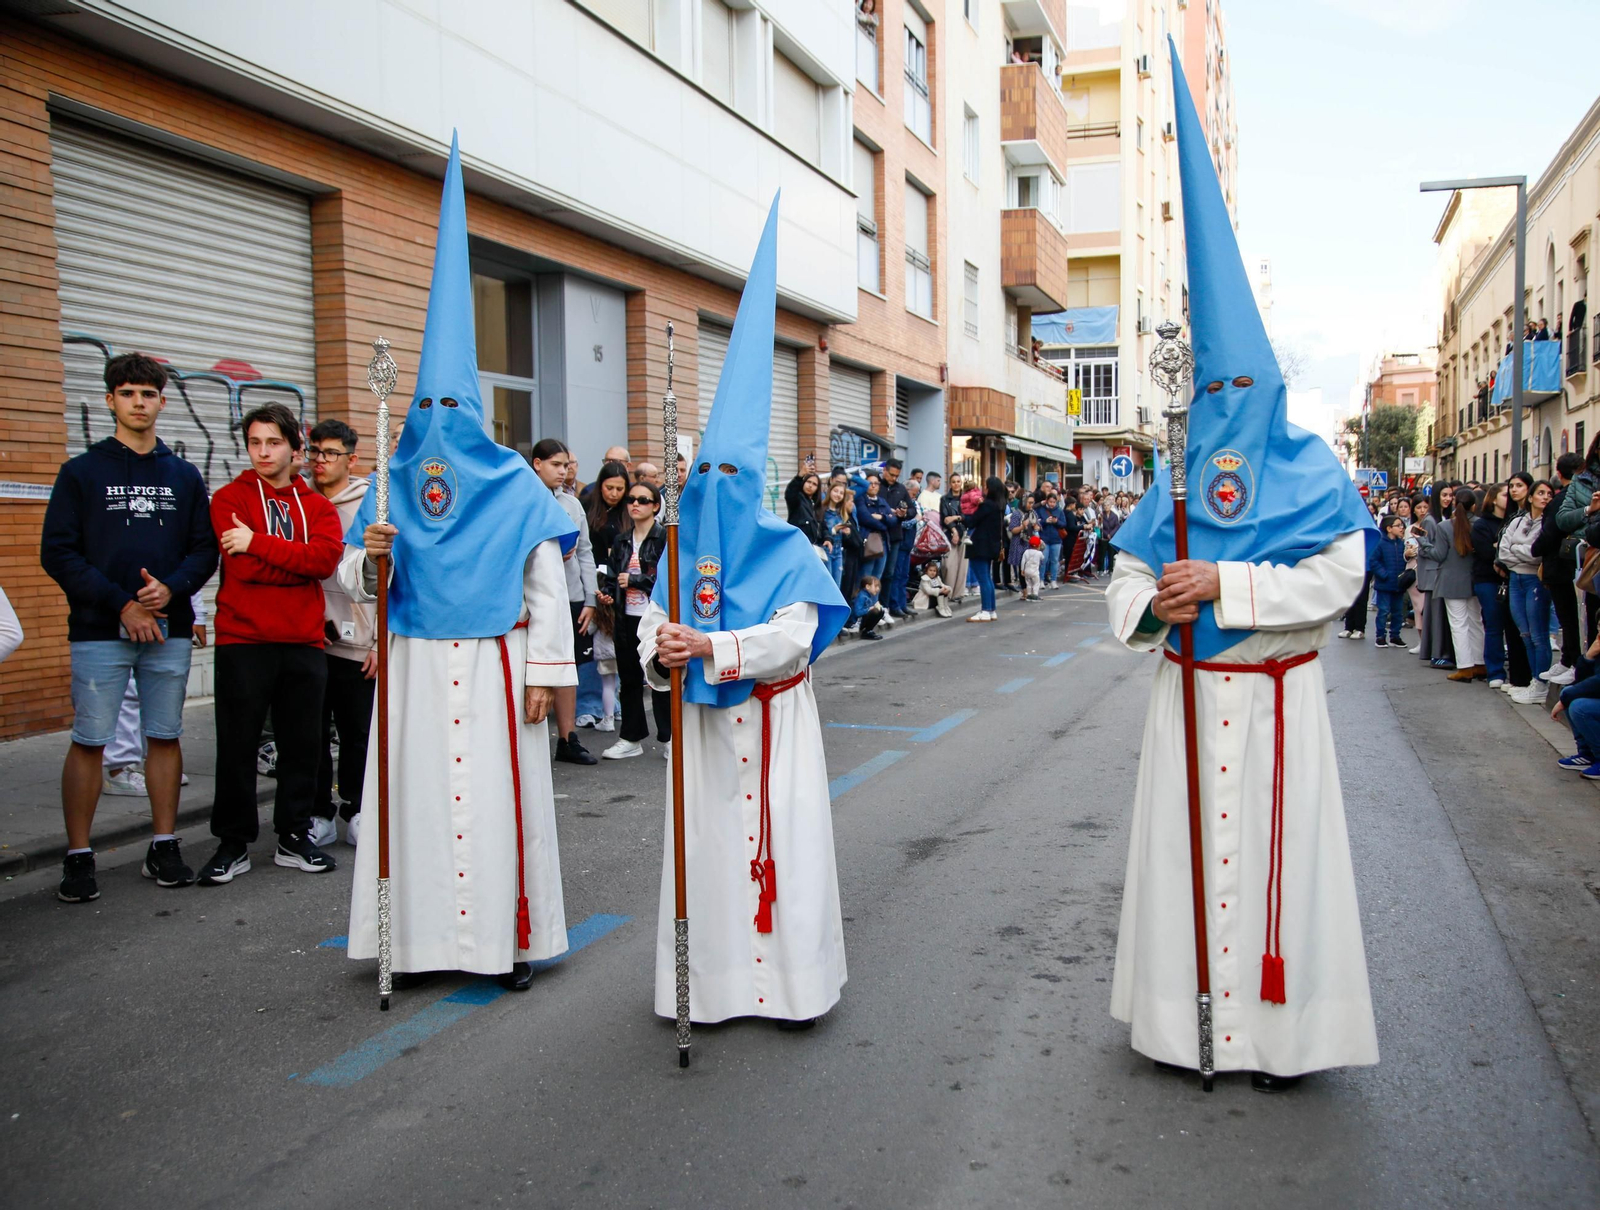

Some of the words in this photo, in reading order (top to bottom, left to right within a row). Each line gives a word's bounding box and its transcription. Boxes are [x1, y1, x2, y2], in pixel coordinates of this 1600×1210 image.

[863, 443, 875, 458] P
[106, 486, 174, 496] HILFIGER
[267, 498, 294, 541] N
